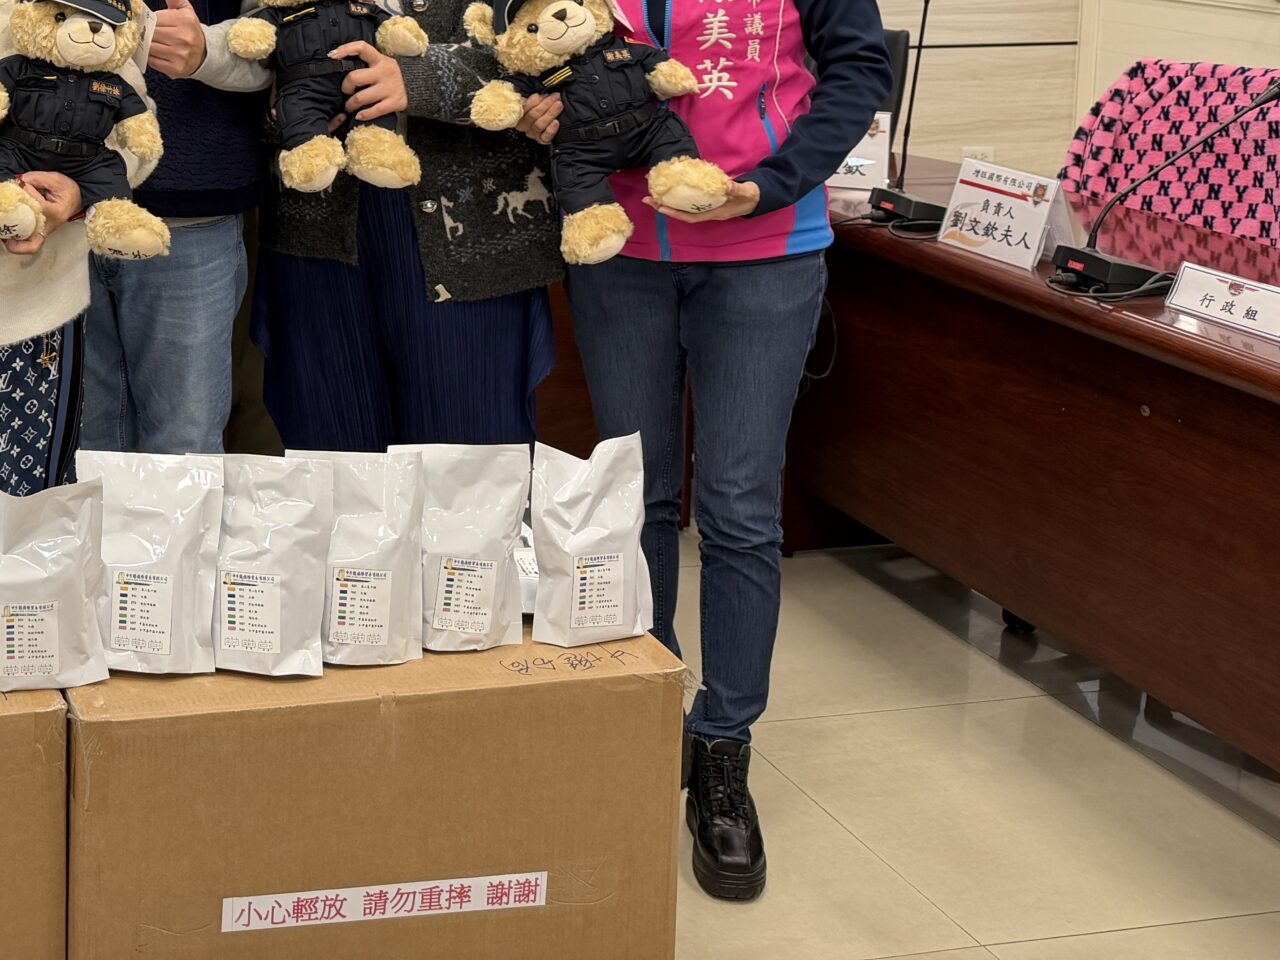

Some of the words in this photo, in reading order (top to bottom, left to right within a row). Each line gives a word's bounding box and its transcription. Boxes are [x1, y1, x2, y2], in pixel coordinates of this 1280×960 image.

[980, 198, 1015, 219] 負責人
[950, 210, 1031, 250] 劉文欽夫人
[1199, 292, 1258, 321] 行政組
[235, 893, 348, 927] 小心輕放
[362, 883, 472, 918] 請勿重摔
[486, 877, 540, 907] 謝謝
